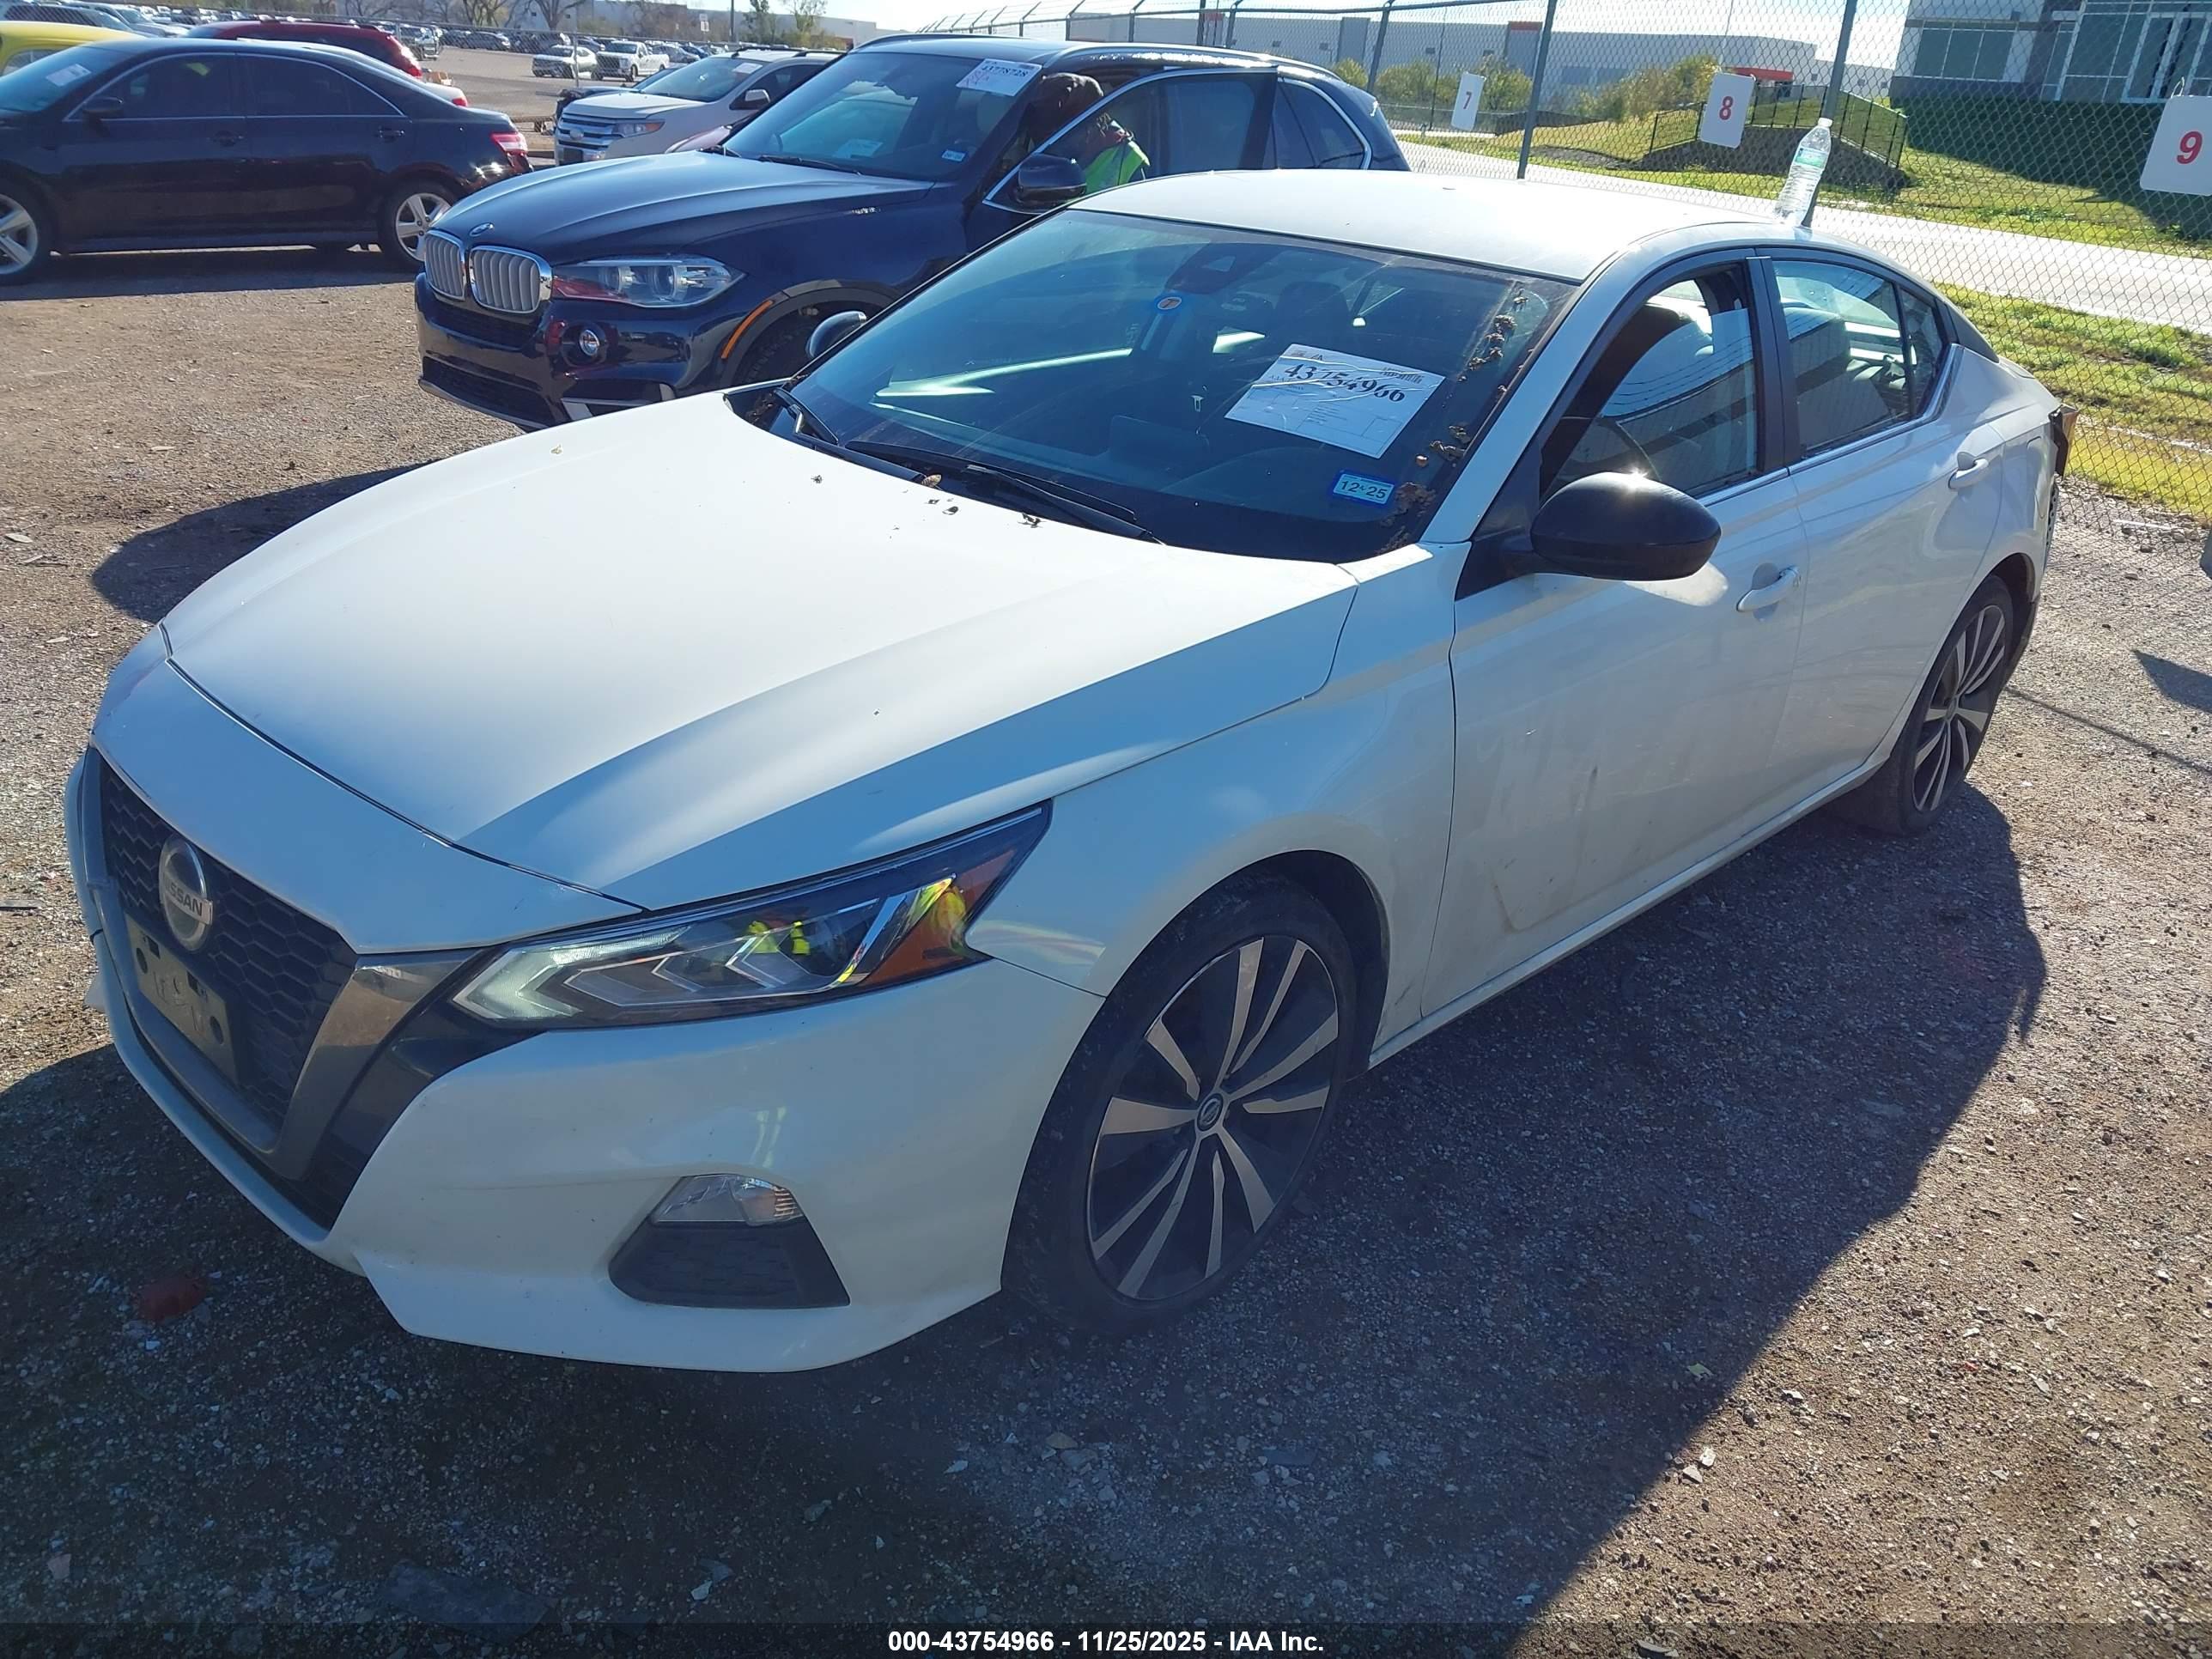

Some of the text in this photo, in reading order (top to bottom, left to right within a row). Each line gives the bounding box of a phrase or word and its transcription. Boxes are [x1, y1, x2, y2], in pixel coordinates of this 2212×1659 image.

[1463, 91, 1473, 110] 7
[1719, 96, 1734, 120] 8
[2177, 131, 2203, 164] 9
[1285, 363, 1406, 402] 43754966
[1340, 481, 1388, 499] 12 25
[164, 873, 203, 917] SSAN
